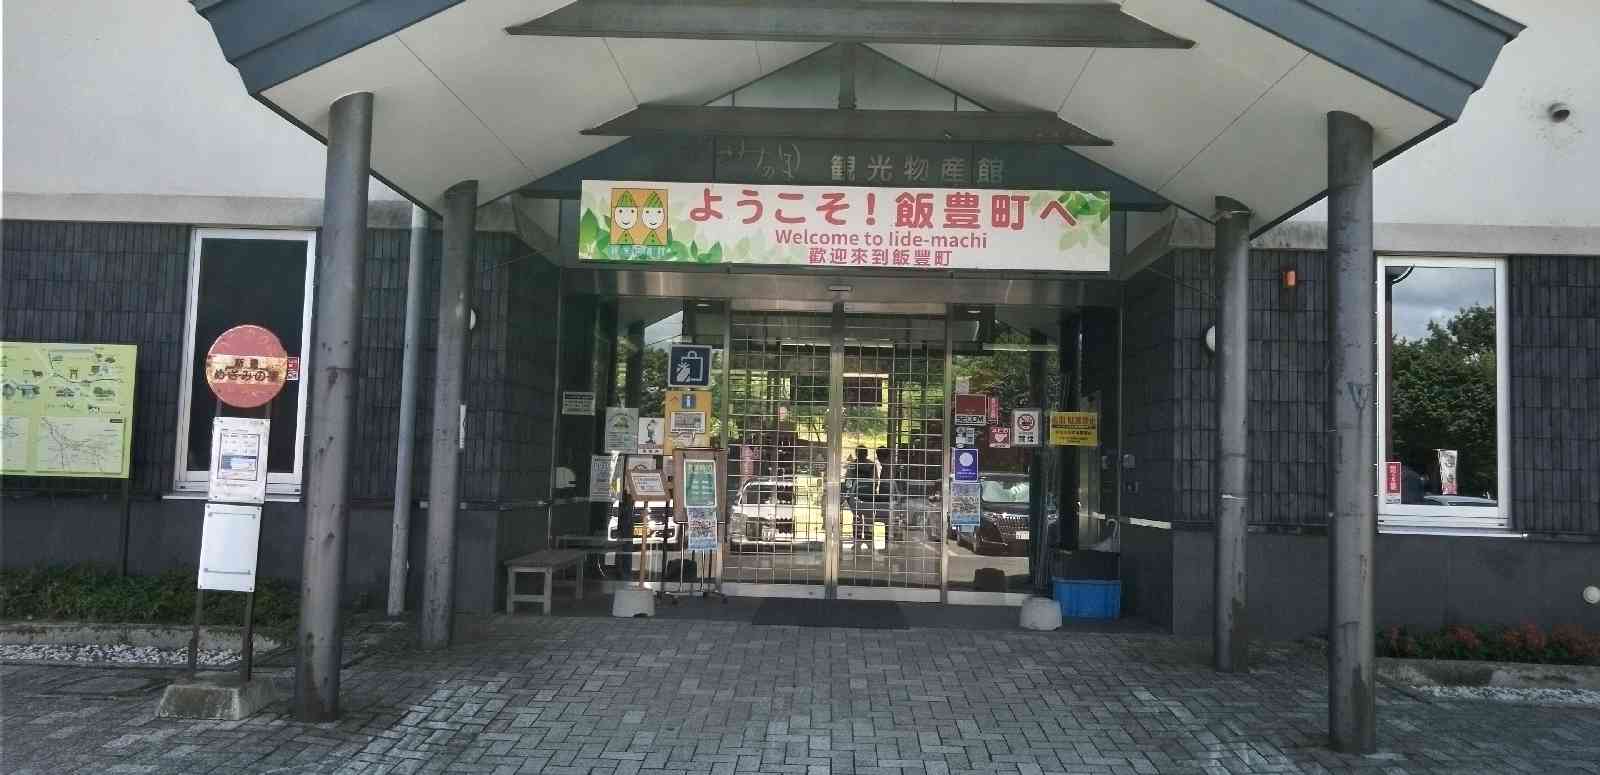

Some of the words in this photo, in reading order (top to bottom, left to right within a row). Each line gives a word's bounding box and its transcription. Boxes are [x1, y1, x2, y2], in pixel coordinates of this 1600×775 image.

[830, 154, 1004, 183] 観光物産館
[689, 188, 1078, 231] ようこそ！飯豊町へ
[775, 230, 859, 246] Welcome
[864, 231, 884, 247] to
[956, 416, 984, 424] SECOM
